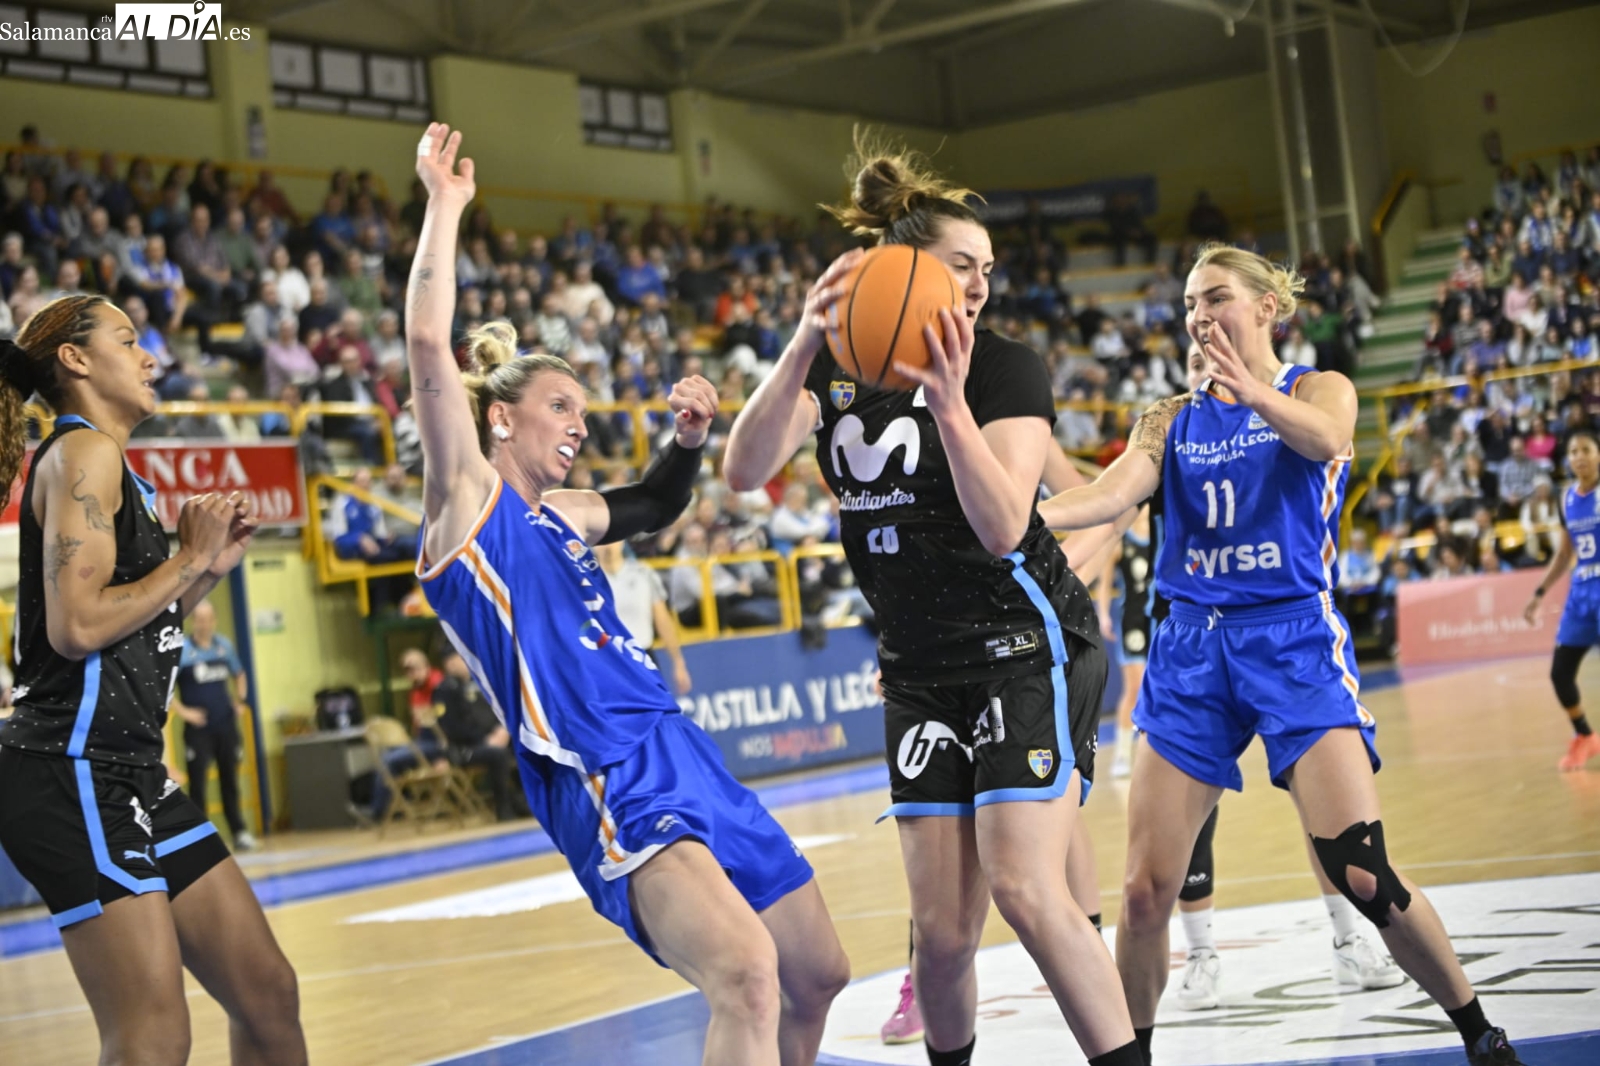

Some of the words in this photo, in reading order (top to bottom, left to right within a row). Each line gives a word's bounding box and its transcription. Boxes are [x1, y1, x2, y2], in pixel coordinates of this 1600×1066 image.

[1239, 430, 1280, 447] LEÓN
[1190, 456, 1206, 466] NOS
[1202, 479, 1236, 529] 11
[1014, 635, 1029, 647] XL
[806, 677, 827, 724] Y
[831, 659, 882, 713] LEÓ
